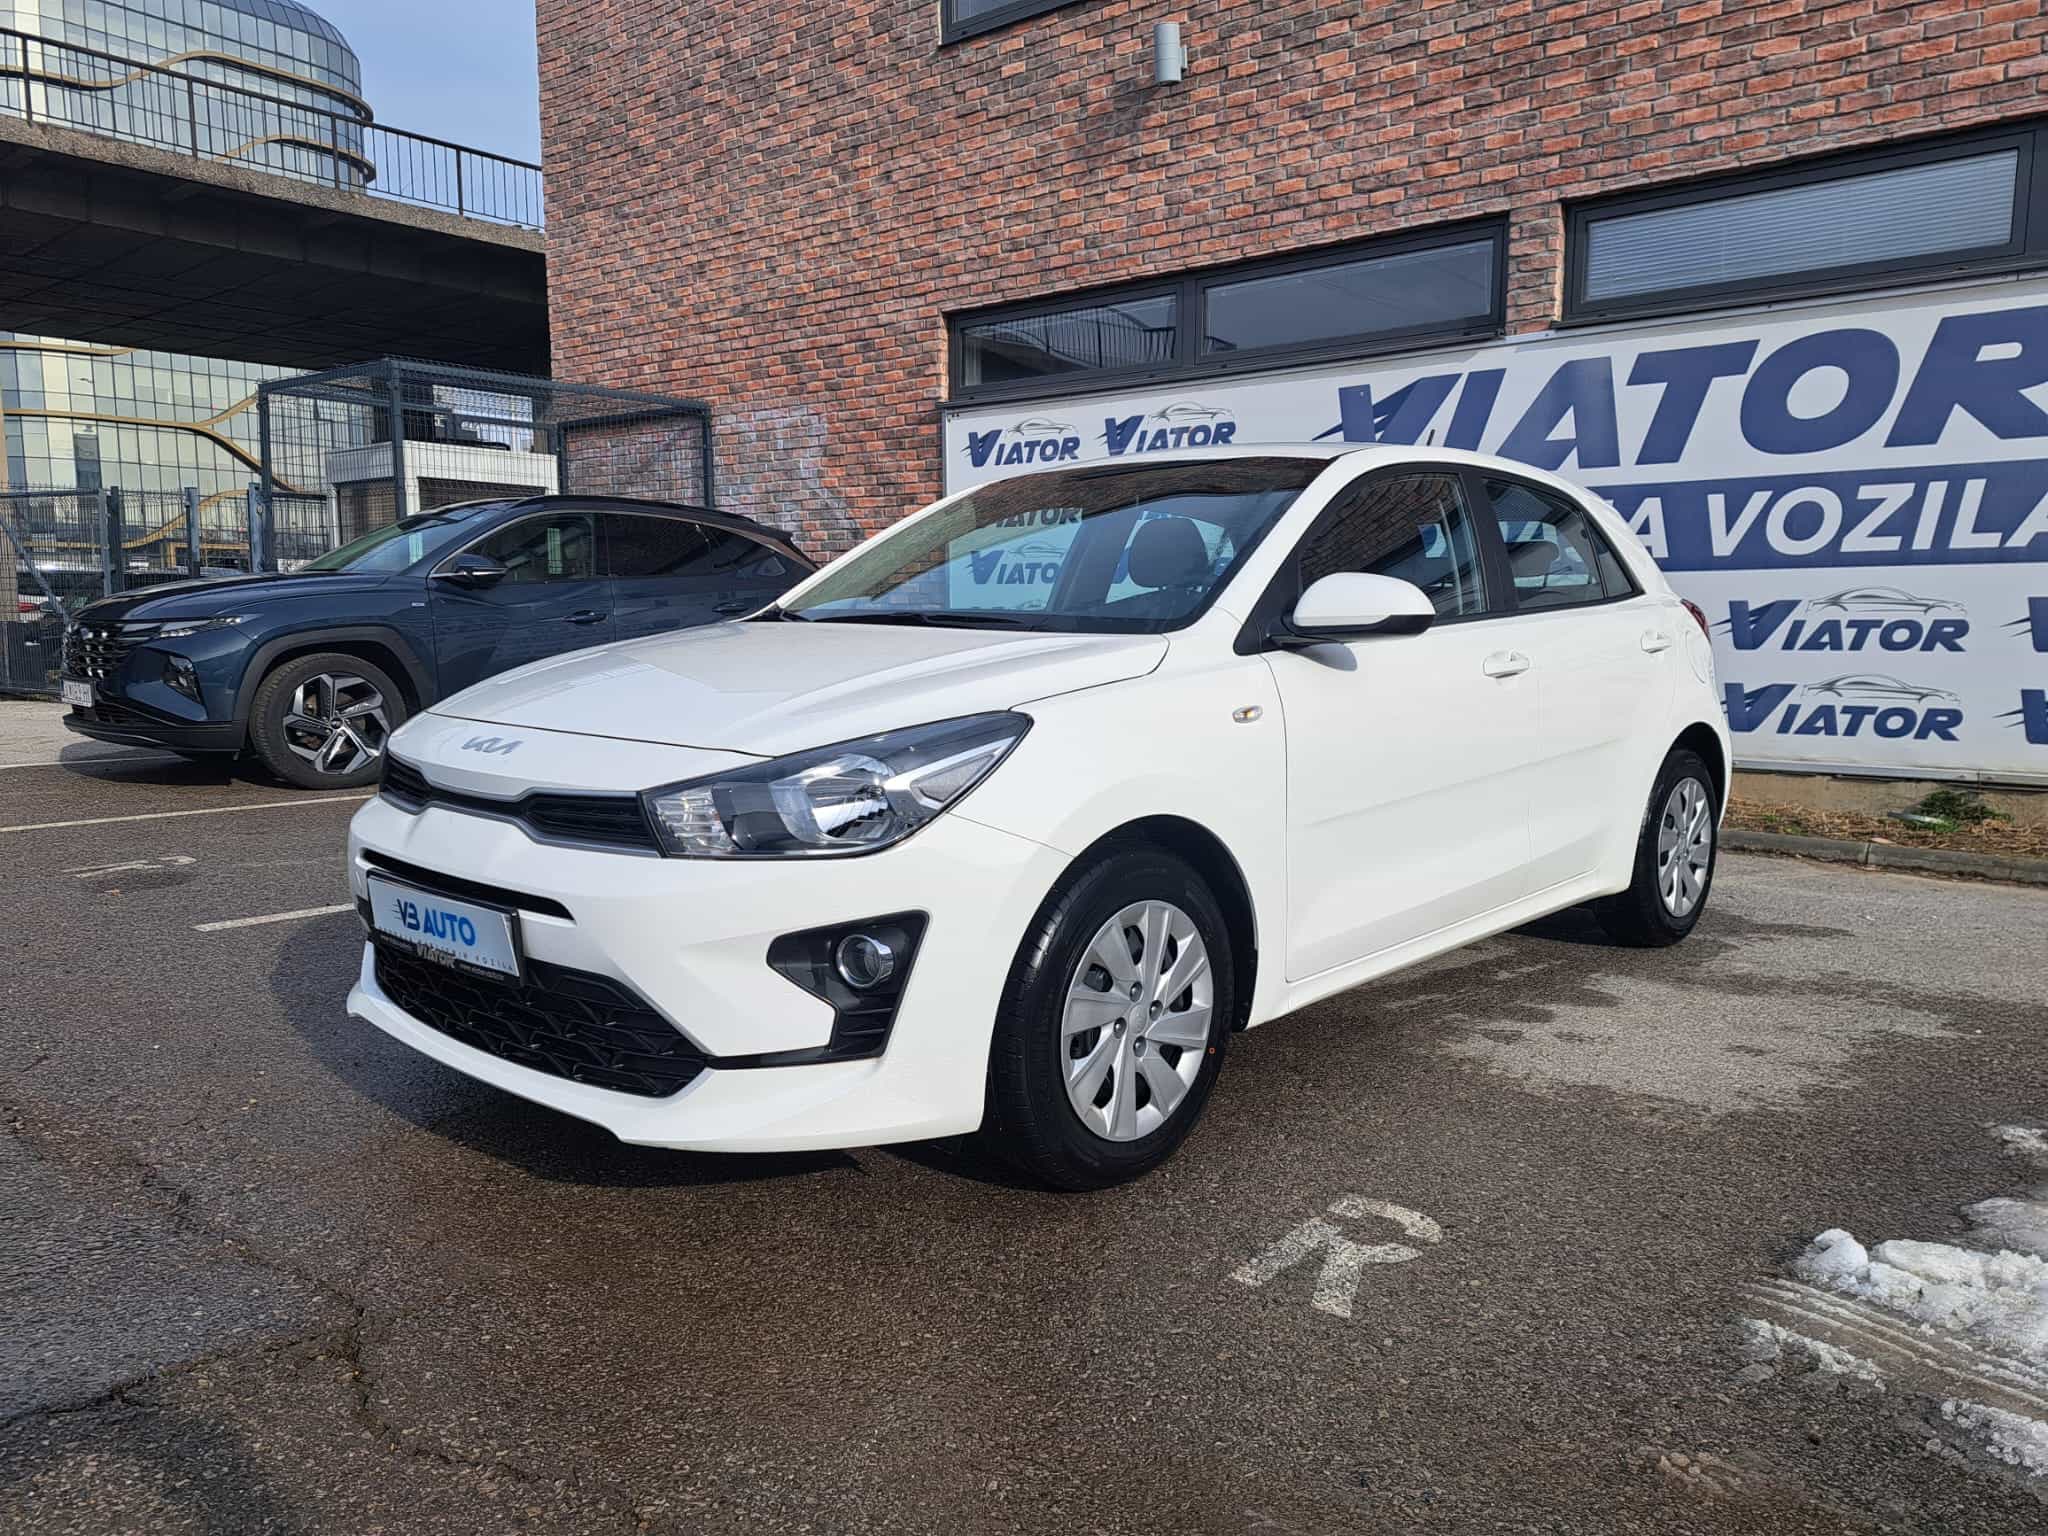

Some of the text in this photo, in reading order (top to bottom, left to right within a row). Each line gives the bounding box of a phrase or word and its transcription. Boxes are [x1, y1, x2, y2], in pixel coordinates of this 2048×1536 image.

[1336, 304, 2048, 470] VIATOR
[967, 428, 1081, 468] VIATOR
[1104, 414, 1237, 457] VIATOR
[970, 549, 1059, 585] VIATO
[1728, 599, 1970, 652] VIATOR
[1724, 682, 1964, 741] VIATOR
[423, 908, 477, 946] AUTO
